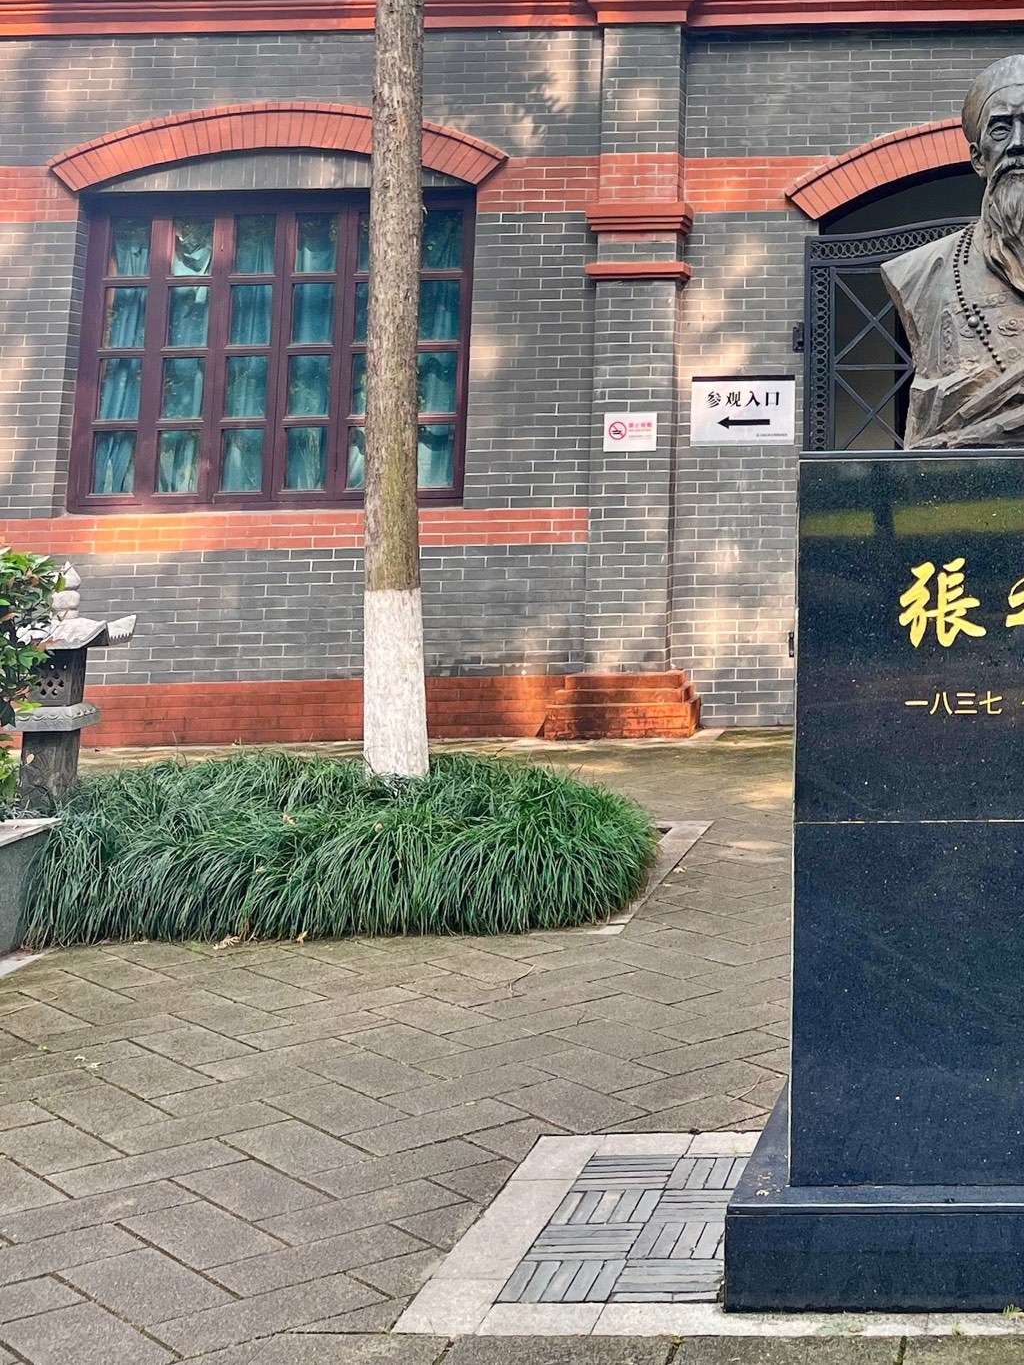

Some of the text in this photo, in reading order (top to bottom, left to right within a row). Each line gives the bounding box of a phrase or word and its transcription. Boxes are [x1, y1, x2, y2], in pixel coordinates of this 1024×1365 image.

[706, 390, 780, 408] 参观入口
[904, 691, 1003, 716] 一八三七
